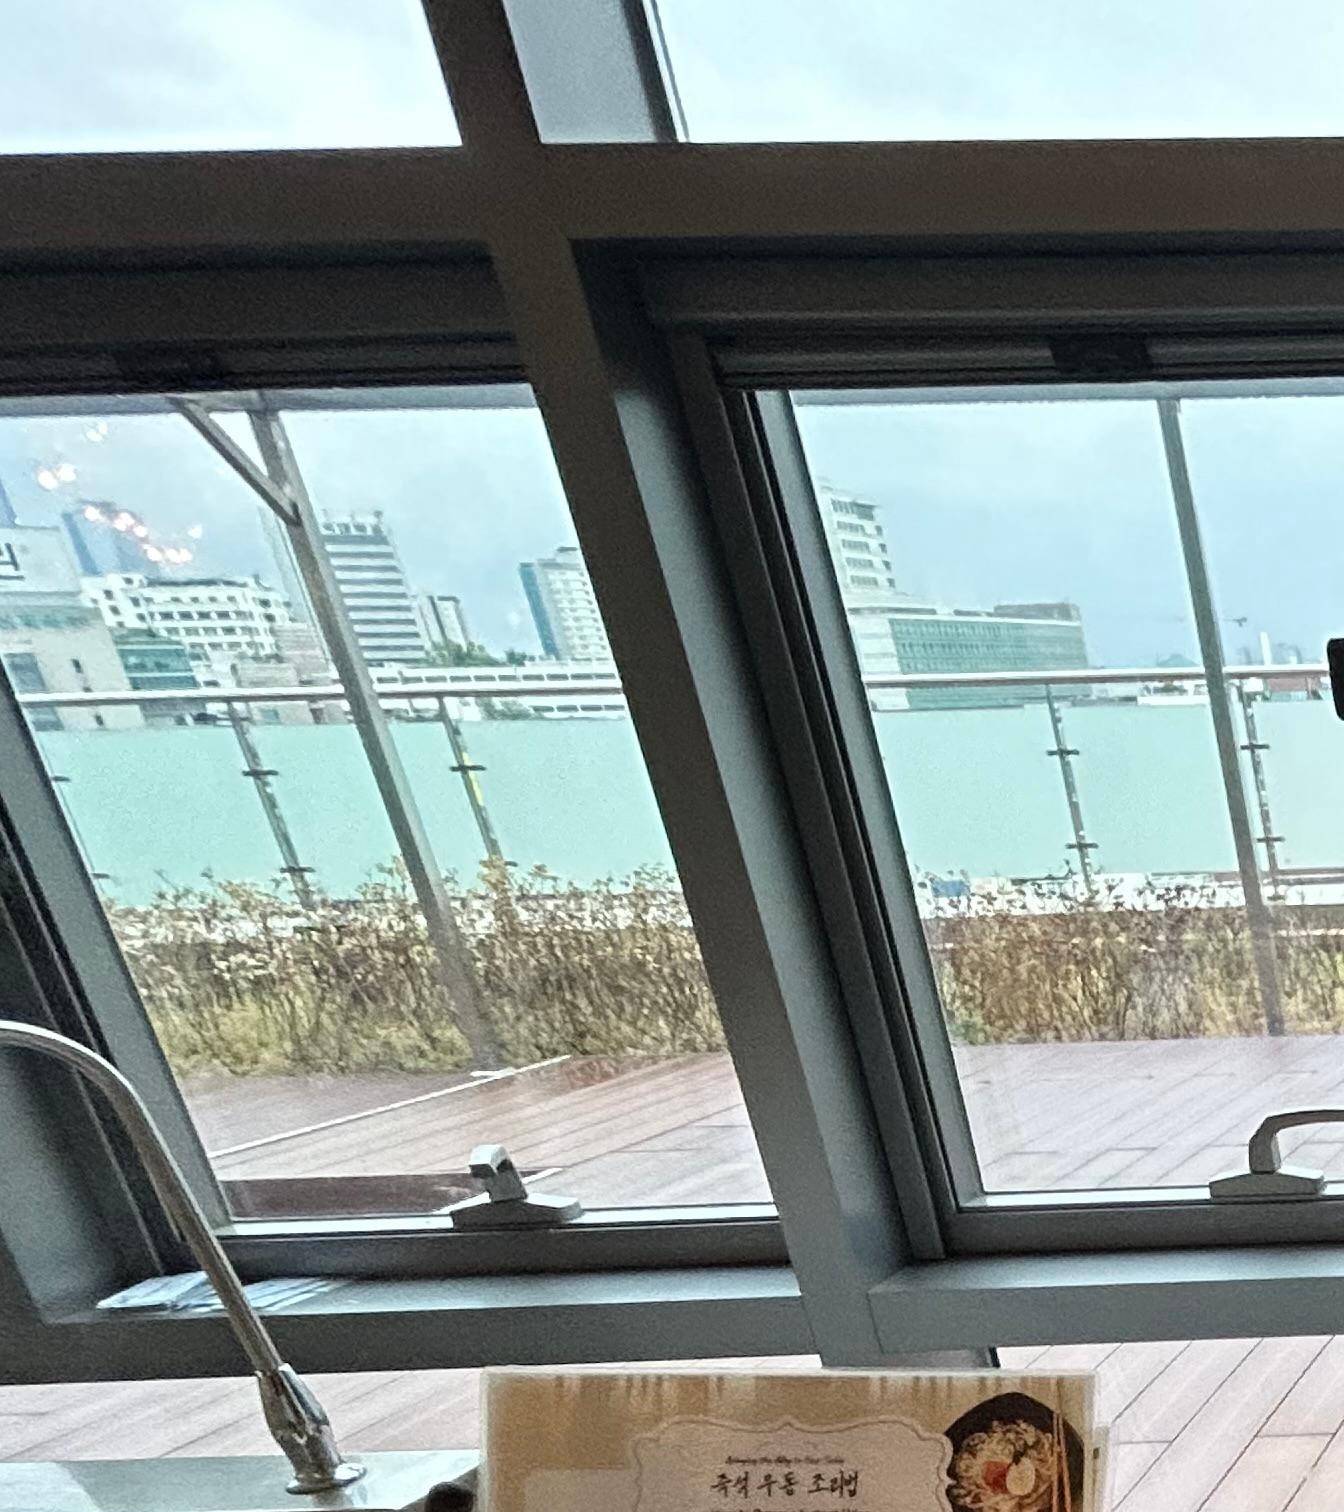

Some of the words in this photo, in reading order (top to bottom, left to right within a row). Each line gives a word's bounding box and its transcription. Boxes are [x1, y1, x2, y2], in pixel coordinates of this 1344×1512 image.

[710, 1470, 750, 1499] 즉석
[757, 1471, 799, 1497] 우동
[807, 1468, 859, 1498] 조리법
